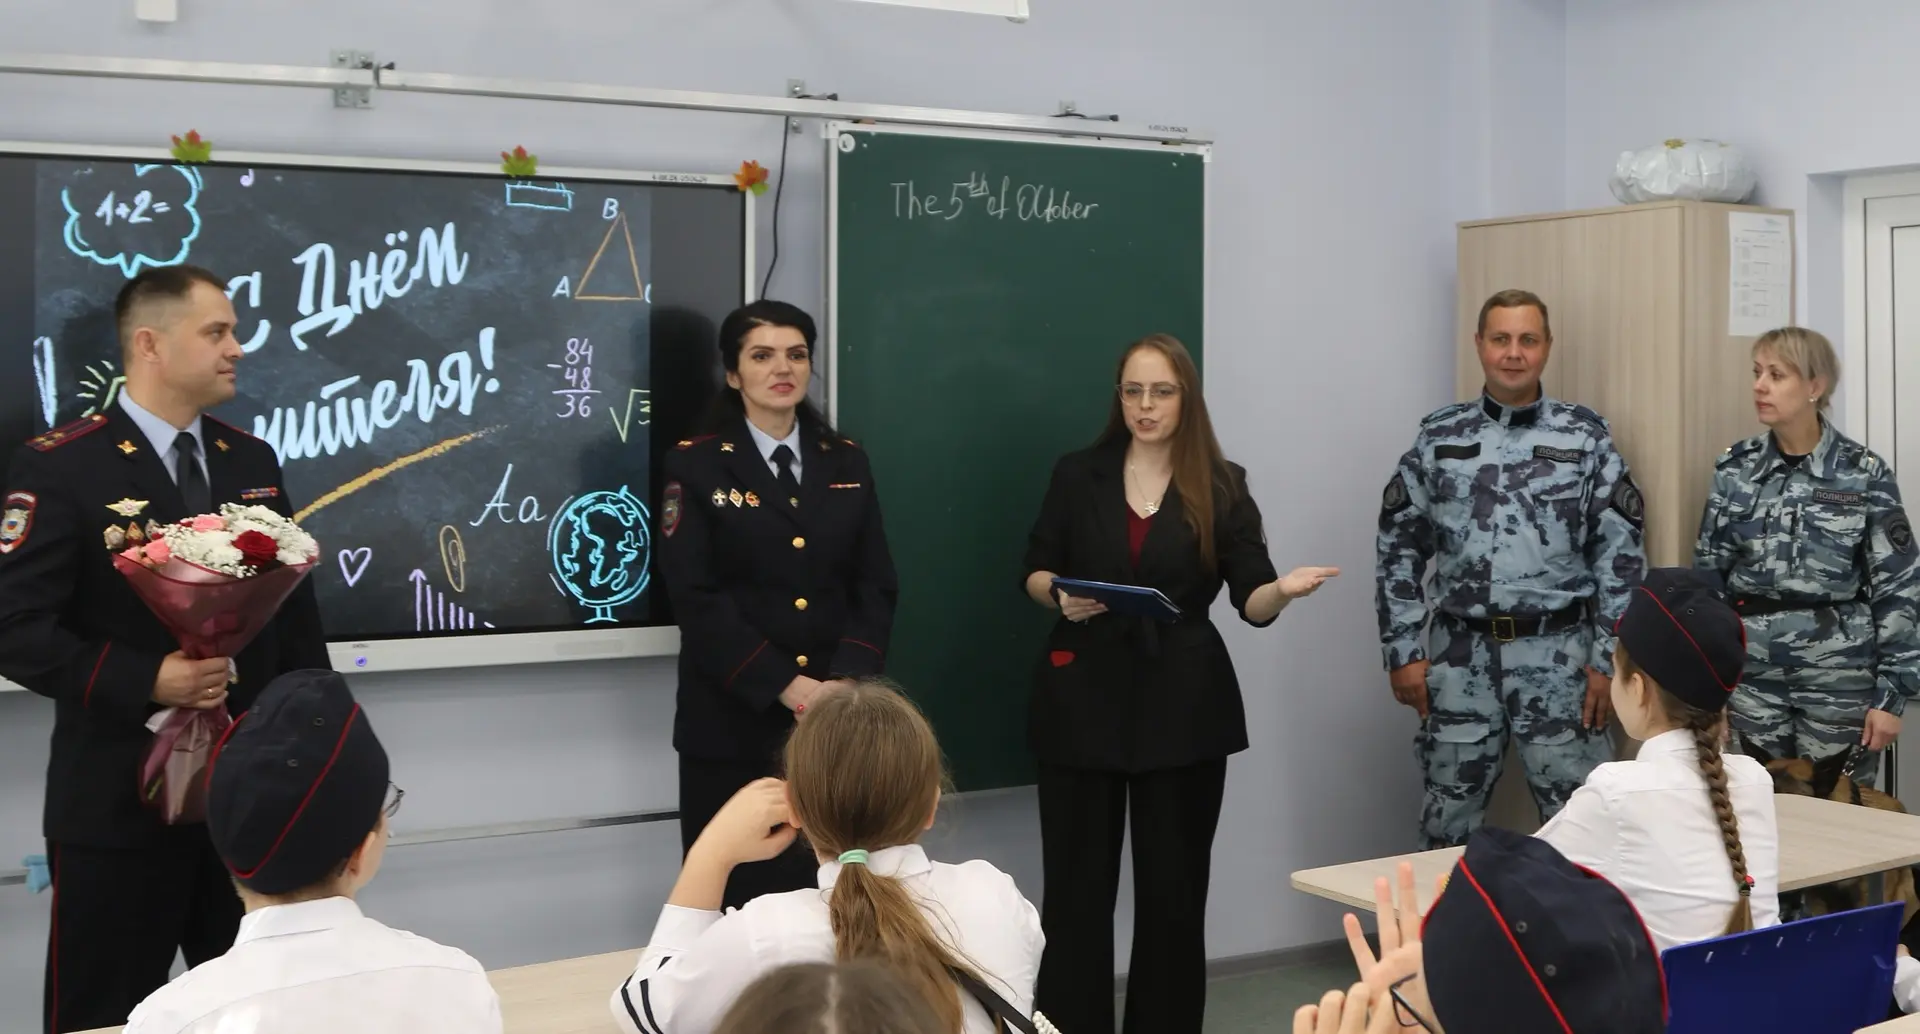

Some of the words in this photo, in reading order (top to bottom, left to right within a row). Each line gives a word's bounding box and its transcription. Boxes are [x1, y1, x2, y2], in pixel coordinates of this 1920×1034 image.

[95, 190, 171, 226] 1+2=
[891, 180, 942, 219] The
[986, 175, 1009, 219] of
[1016, 183, 1099, 223] October
[290, 222, 469, 351] Днём
[565, 338, 593, 365] 84
[253, 327, 500, 468] чителя!
[556, 394, 591, 417] 36
[1539, 447, 1579, 460] ПОЛИЦИЯ
[1816, 490, 1860, 504] ПОЛИЦИЯ
